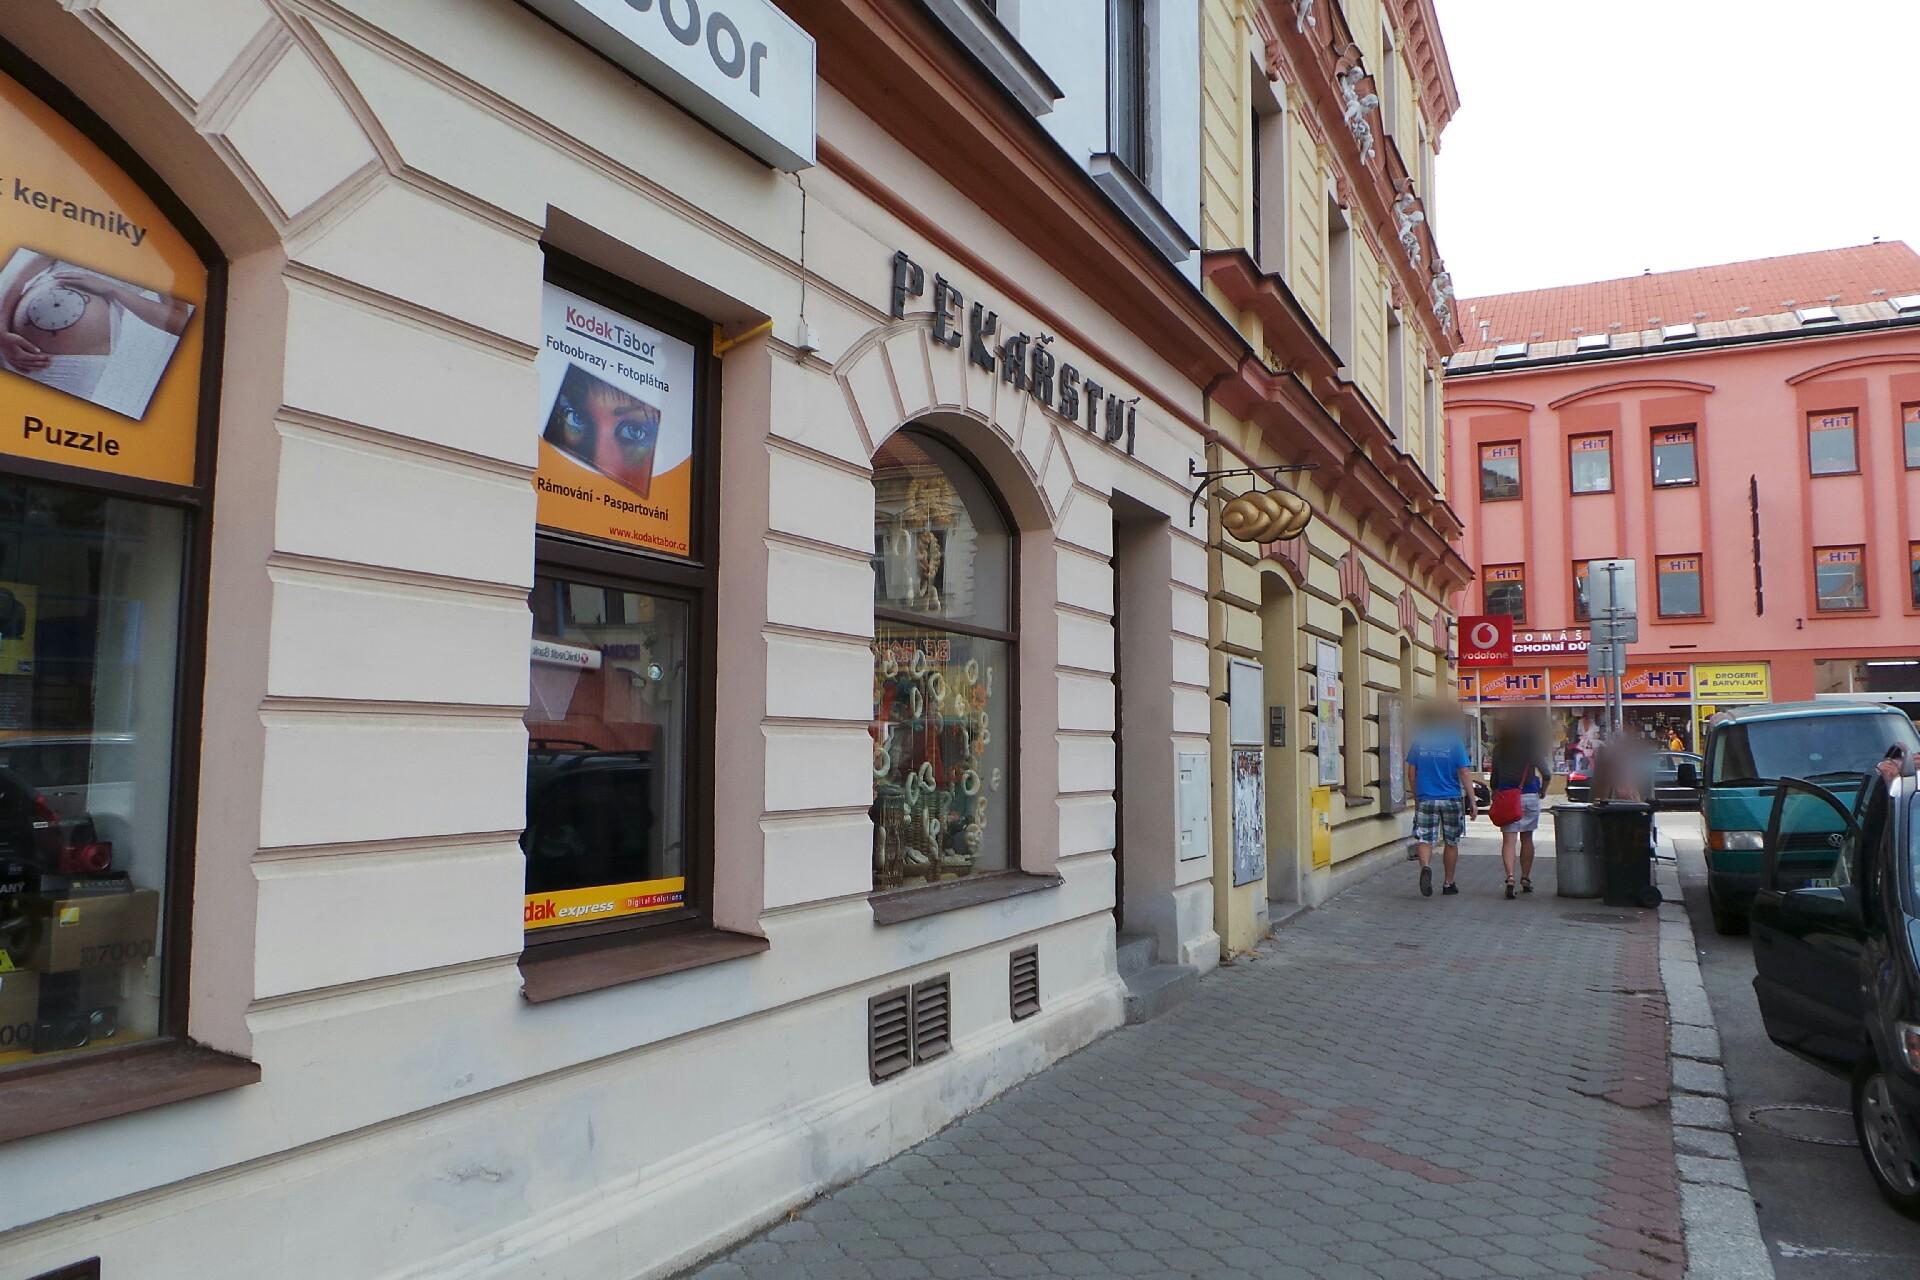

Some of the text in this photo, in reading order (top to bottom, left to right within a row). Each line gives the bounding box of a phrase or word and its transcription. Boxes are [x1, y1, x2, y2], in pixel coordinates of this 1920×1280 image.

[13, 177, 147, 247] keramiky
[566, 305, 614, 341] Kodak
[546, 334, 608, 371] Fotoobrazy
[617, 362, 670, 393] Fotoplátna
[891, 249, 1141, 456] PEKAŘSTVÍ
[1822, 416, 1851, 428] HiT
[23, 415, 120, 456] Puzzle
[537, 476, 593, 503] Rámování
[603, 494, 669, 522] Paspartování
[609, 526, 687, 551] www.kodaktabor.cz
[1462, 651, 1509, 660] vodafone
[1512, 641, 1591, 653] CHODNÍ DŮ
[1505, 674, 1543, 689] HiT
[1648, 671, 1687, 687] HiT
[558, 900, 615, 918] express
[627, 896, 651, 909] Digital
[652, 893, 683, 905] Solutions
